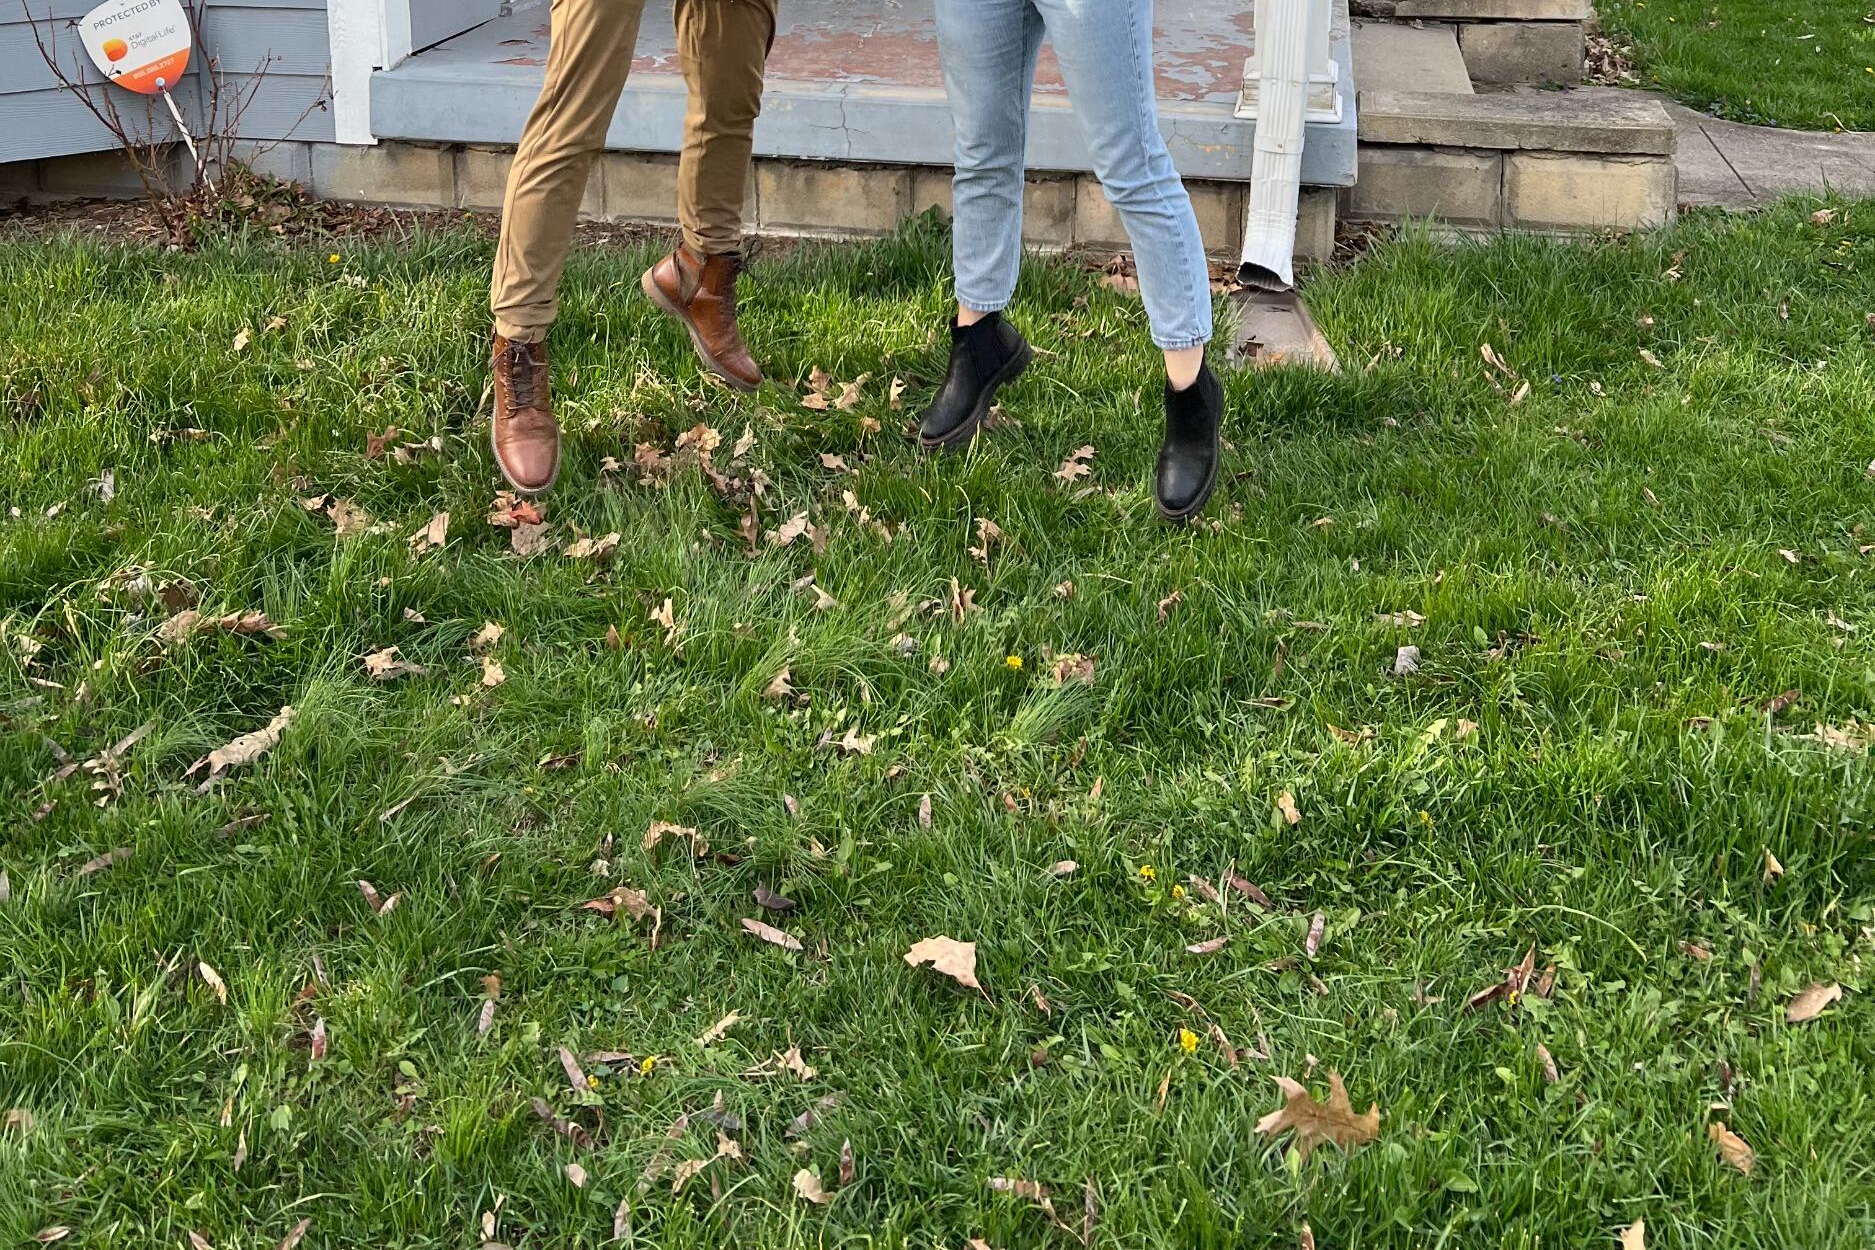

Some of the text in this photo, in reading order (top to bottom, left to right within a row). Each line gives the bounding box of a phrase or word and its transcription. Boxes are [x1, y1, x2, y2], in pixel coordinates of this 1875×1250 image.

[93, 2, 148, 30] PROTECTED
[131, 26, 175, 50] Digital Life
